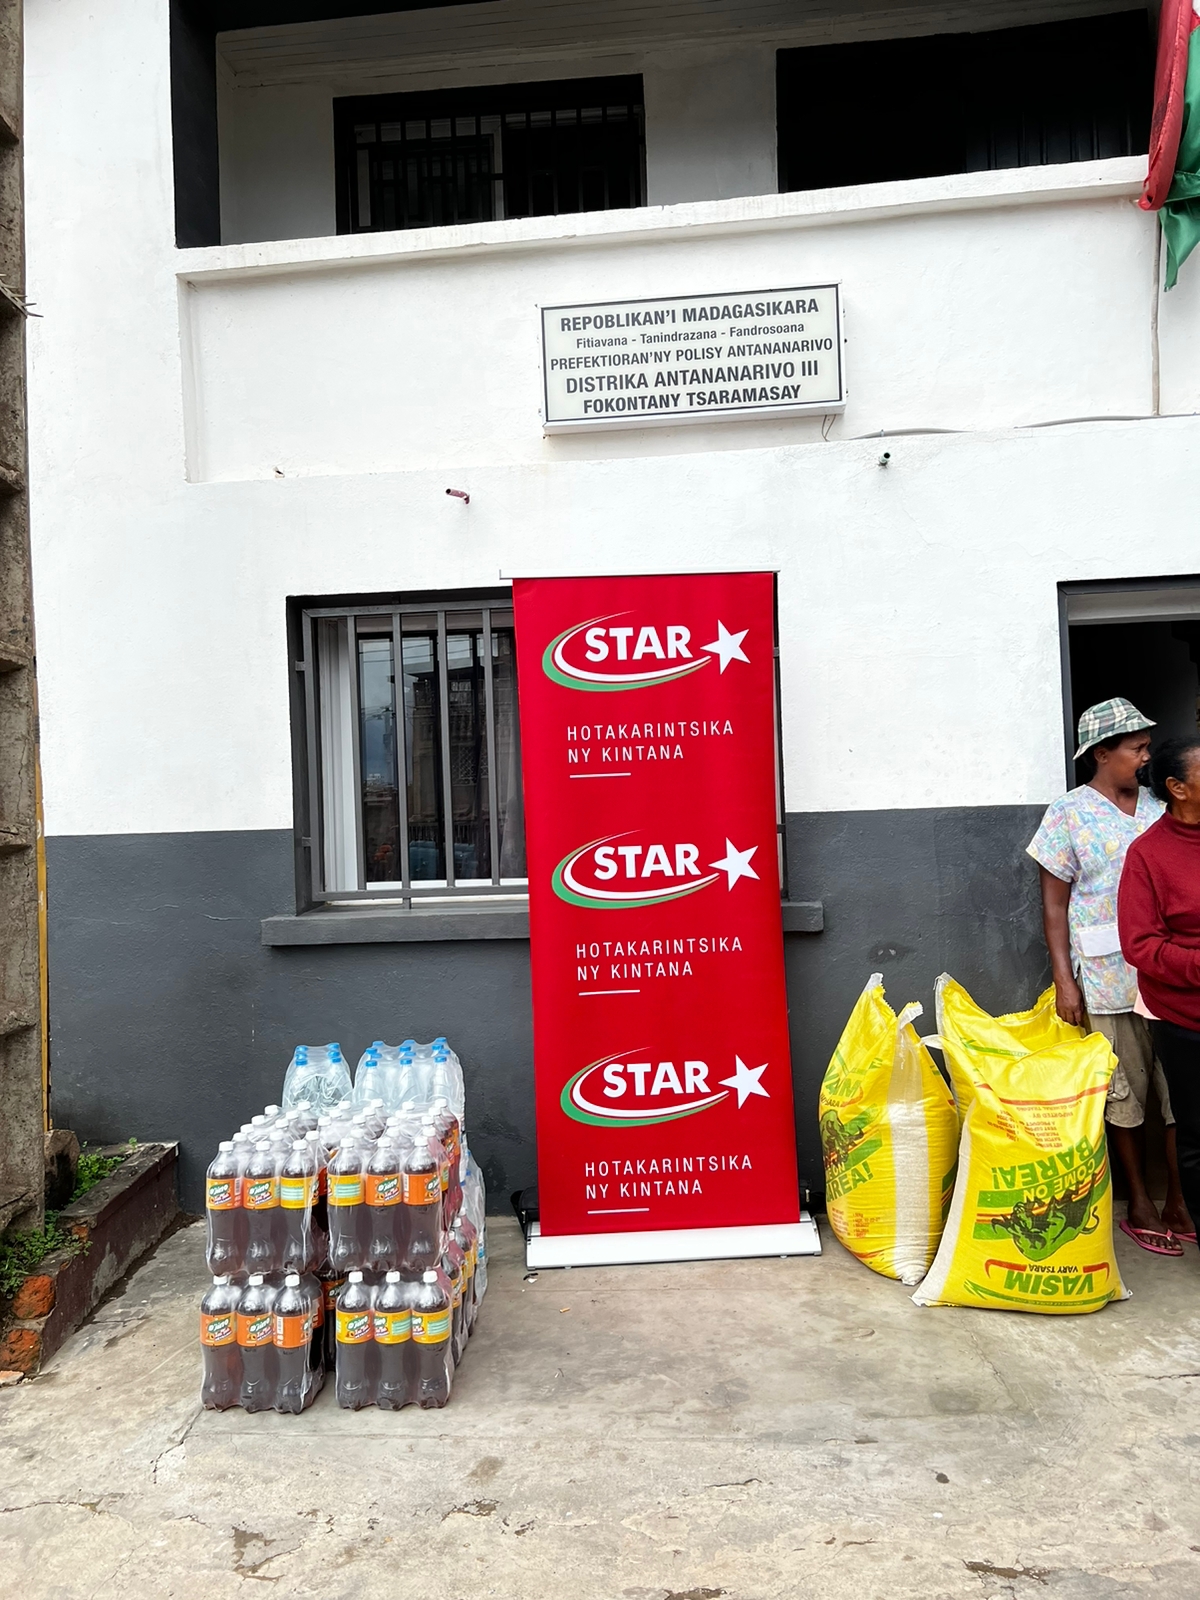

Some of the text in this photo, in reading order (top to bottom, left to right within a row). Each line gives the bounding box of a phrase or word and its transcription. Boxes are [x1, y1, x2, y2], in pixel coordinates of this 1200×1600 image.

[560, 298, 819, 332] REPOBLIKAN'I MADAGASIKARA
[576, 335, 628, 349] Fitiavana
[640, 329, 717, 345] Tanindrazana
[729, 322, 805, 338] Fandrosoana
[550, 338, 833, 371] PREFEKTIORAN'NY POLISY ANTANANARIVO
[566, 360, 819, 394] DISTRIKA ANTANANARIVO III
[583, 385, 802, 414] FOKONTANY TSARAMASAY
[585, 625, 693, 662] STAR
[567, 720, 734, 741] HOTAKARINTSIKA
[568, 744, 684, 764] NY KINTANA
[594, 843, 702, 881] STAR
[576, 936, 743, 959] HOTAKARINTSIKA
[577, 961, 693, 981] NY KINTANA
[603, 1060, 711, 1098] STAR
[585, 1155, 752, 1178] HOTAKARINTSIKA
[991, 1135, 1094, 1190] BAREA!
[586, 1179, 703, 1200] NY KINTANA
[826, 1160, 874, 1203] AREA!
[1023, 1158, 1096, 1202] COME ON
[1003, 1269, 1094, 1296] VASIM
[1028, 1263, 1079, 1274] VARY TSARA
